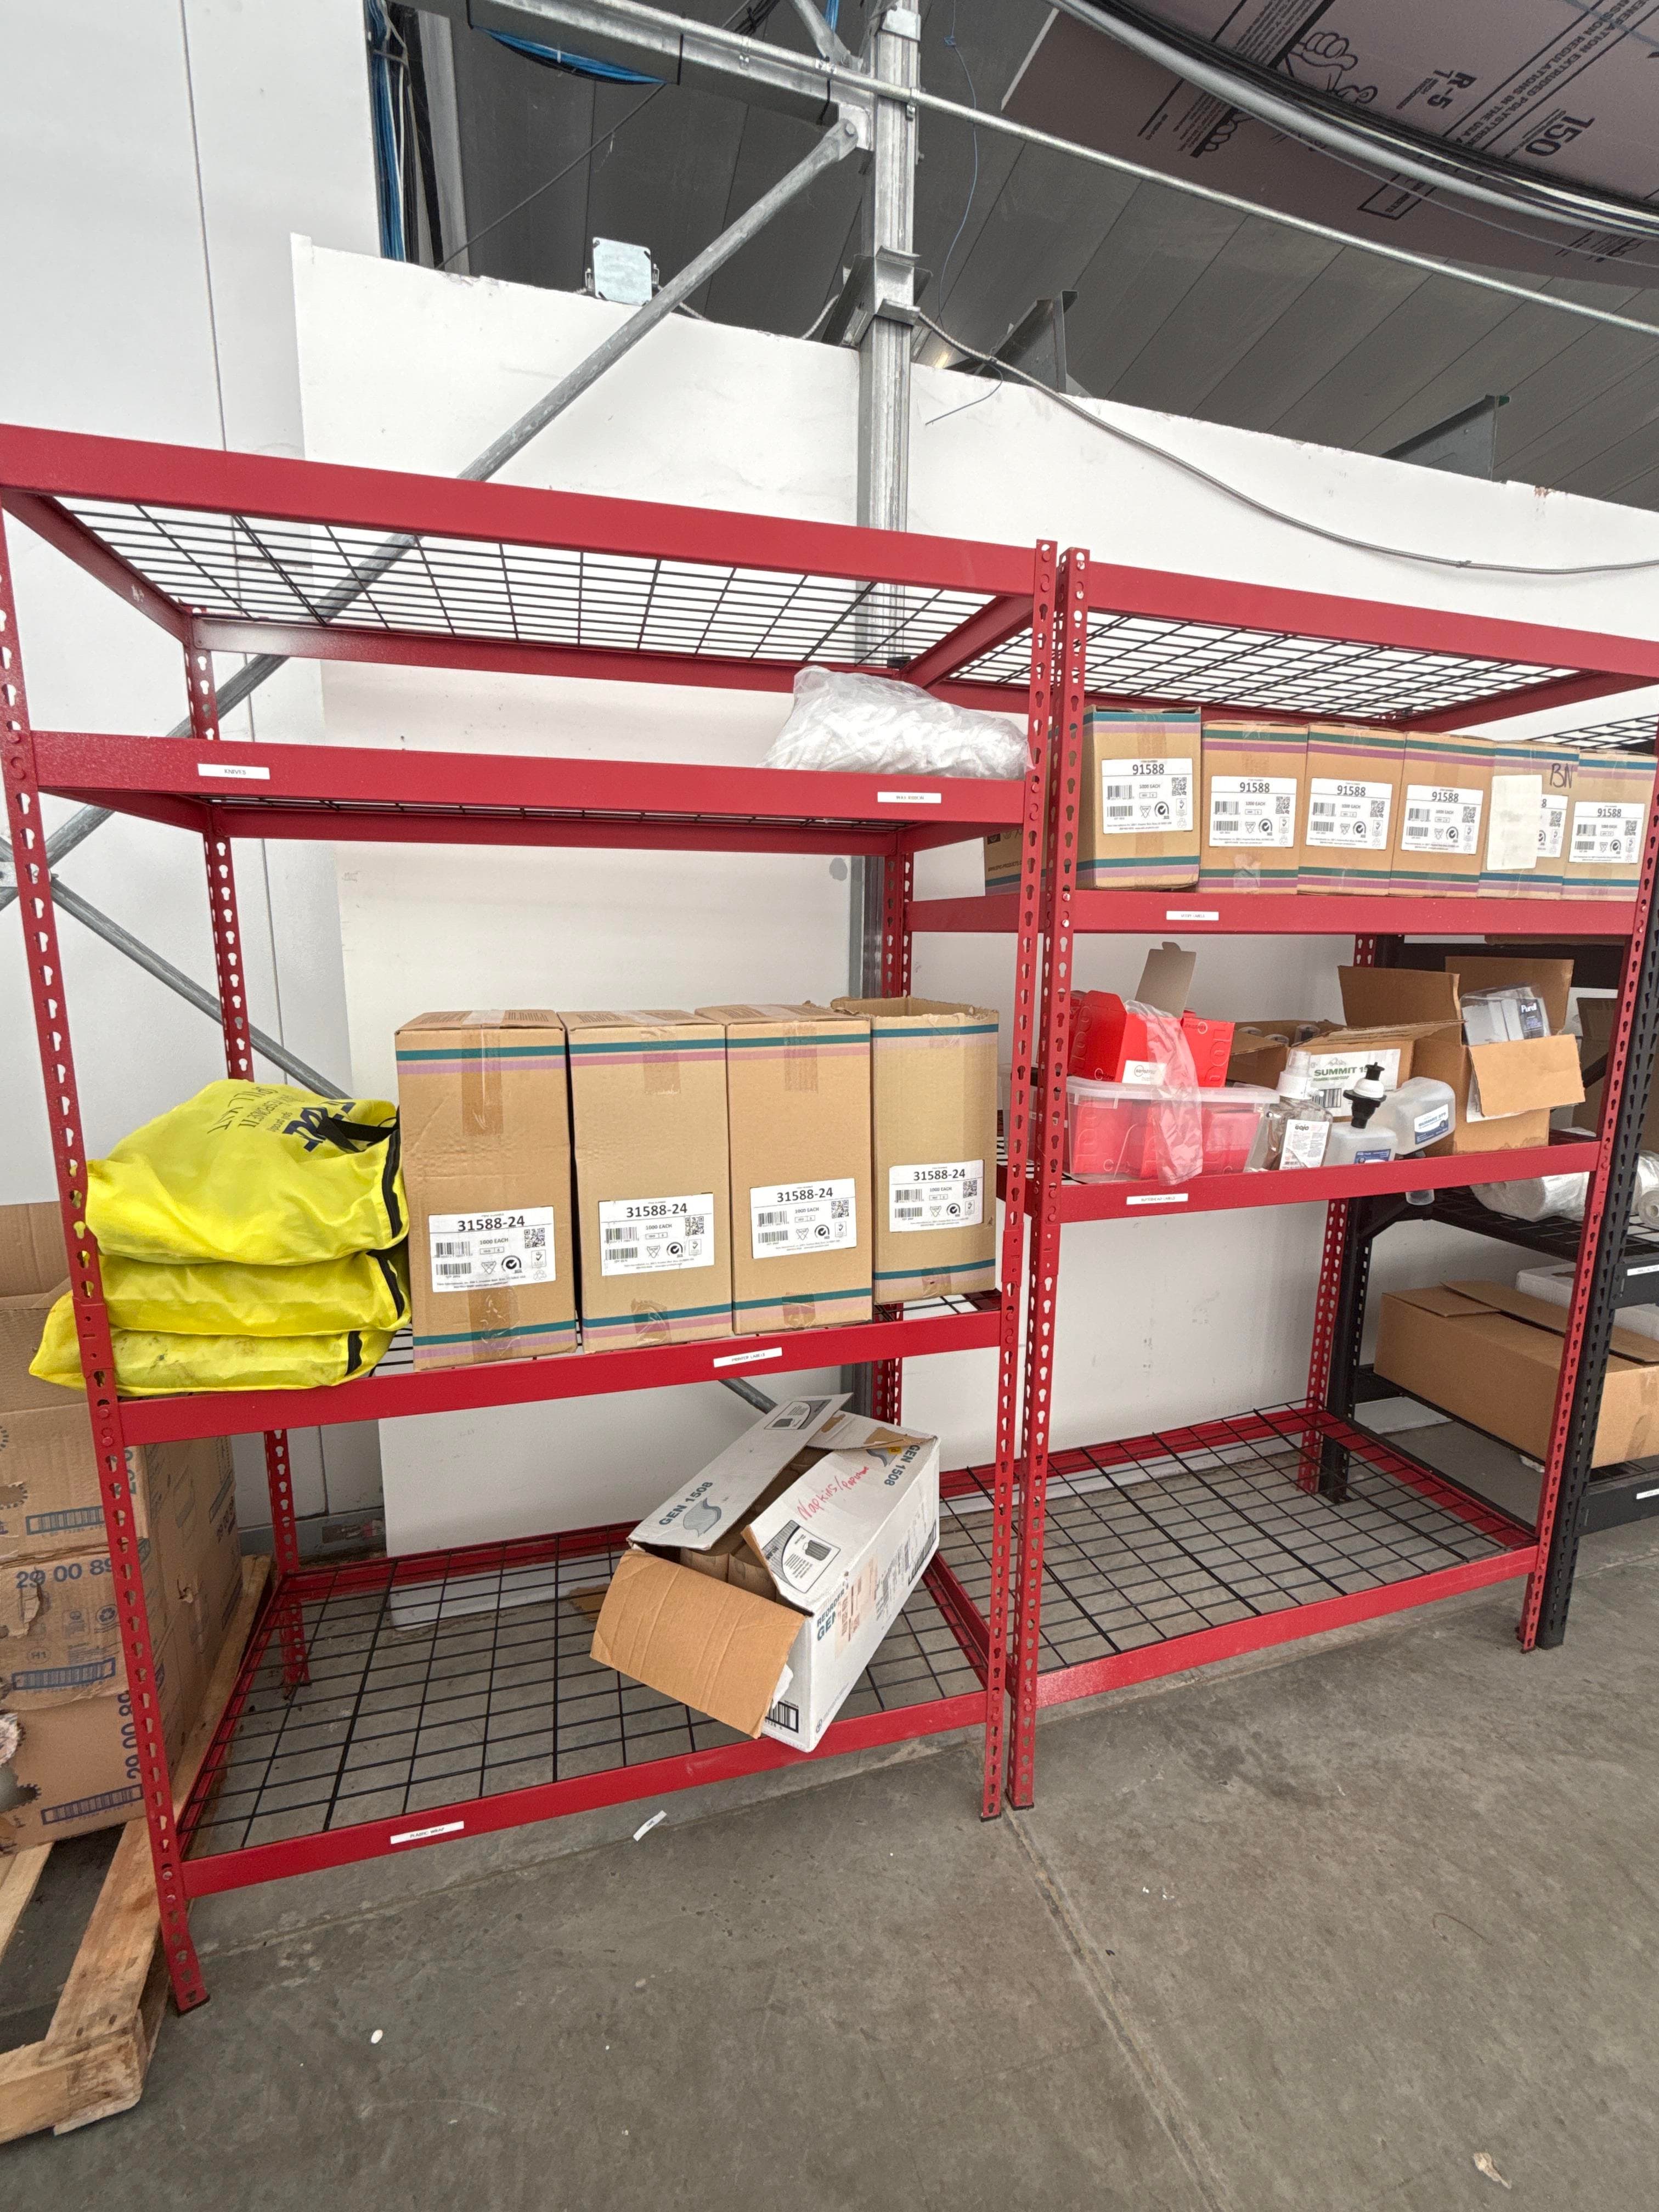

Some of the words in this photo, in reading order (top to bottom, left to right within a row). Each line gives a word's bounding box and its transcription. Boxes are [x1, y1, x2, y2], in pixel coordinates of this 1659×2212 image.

[1579, 0, 1647, 53] ENERATION
[1512, 36, 1585, 94] REGULATIONS
[1527, 54, 1582, 96] EXTRUDED
[1427, 72, 1477, 109] R-5
[1465, 96, 1528, 146] POLYSTYREN
[1480, 104, 1504, 121] THE
[1461, 121, 1483, 137] USA
[1525, 116, 1595, 156] 150
[1132, 764, 1164, 775] 91588
[1240, 782, 1269, 793] 91588
[1337, 785, 1365, 797] 91588
[1432, 792, 1459, 803] 91588
[1598, 808, 1621, 817] 91588
[1314, 1067, 1357, 1076] SUMMIT
[913, 1169, 966, 1181] 31588-24
[777, 1187, 833, 1203] 31588-24
[627, 1203, 687, 1218] 31588-24
[458, 1215, 525, 1231] 31588-24
[900, 1444, 920, 1463] GEN
[884, 1465, 906, 1486] 1508
[659, 1505, 687, 1525] GEN
[685, 1482, 713, 1502] 1508
[16, 1570, 46, 1589] 29
[53, 1564, 83, 1582] 00
[817, 1589, 844, 1627] REORDER
